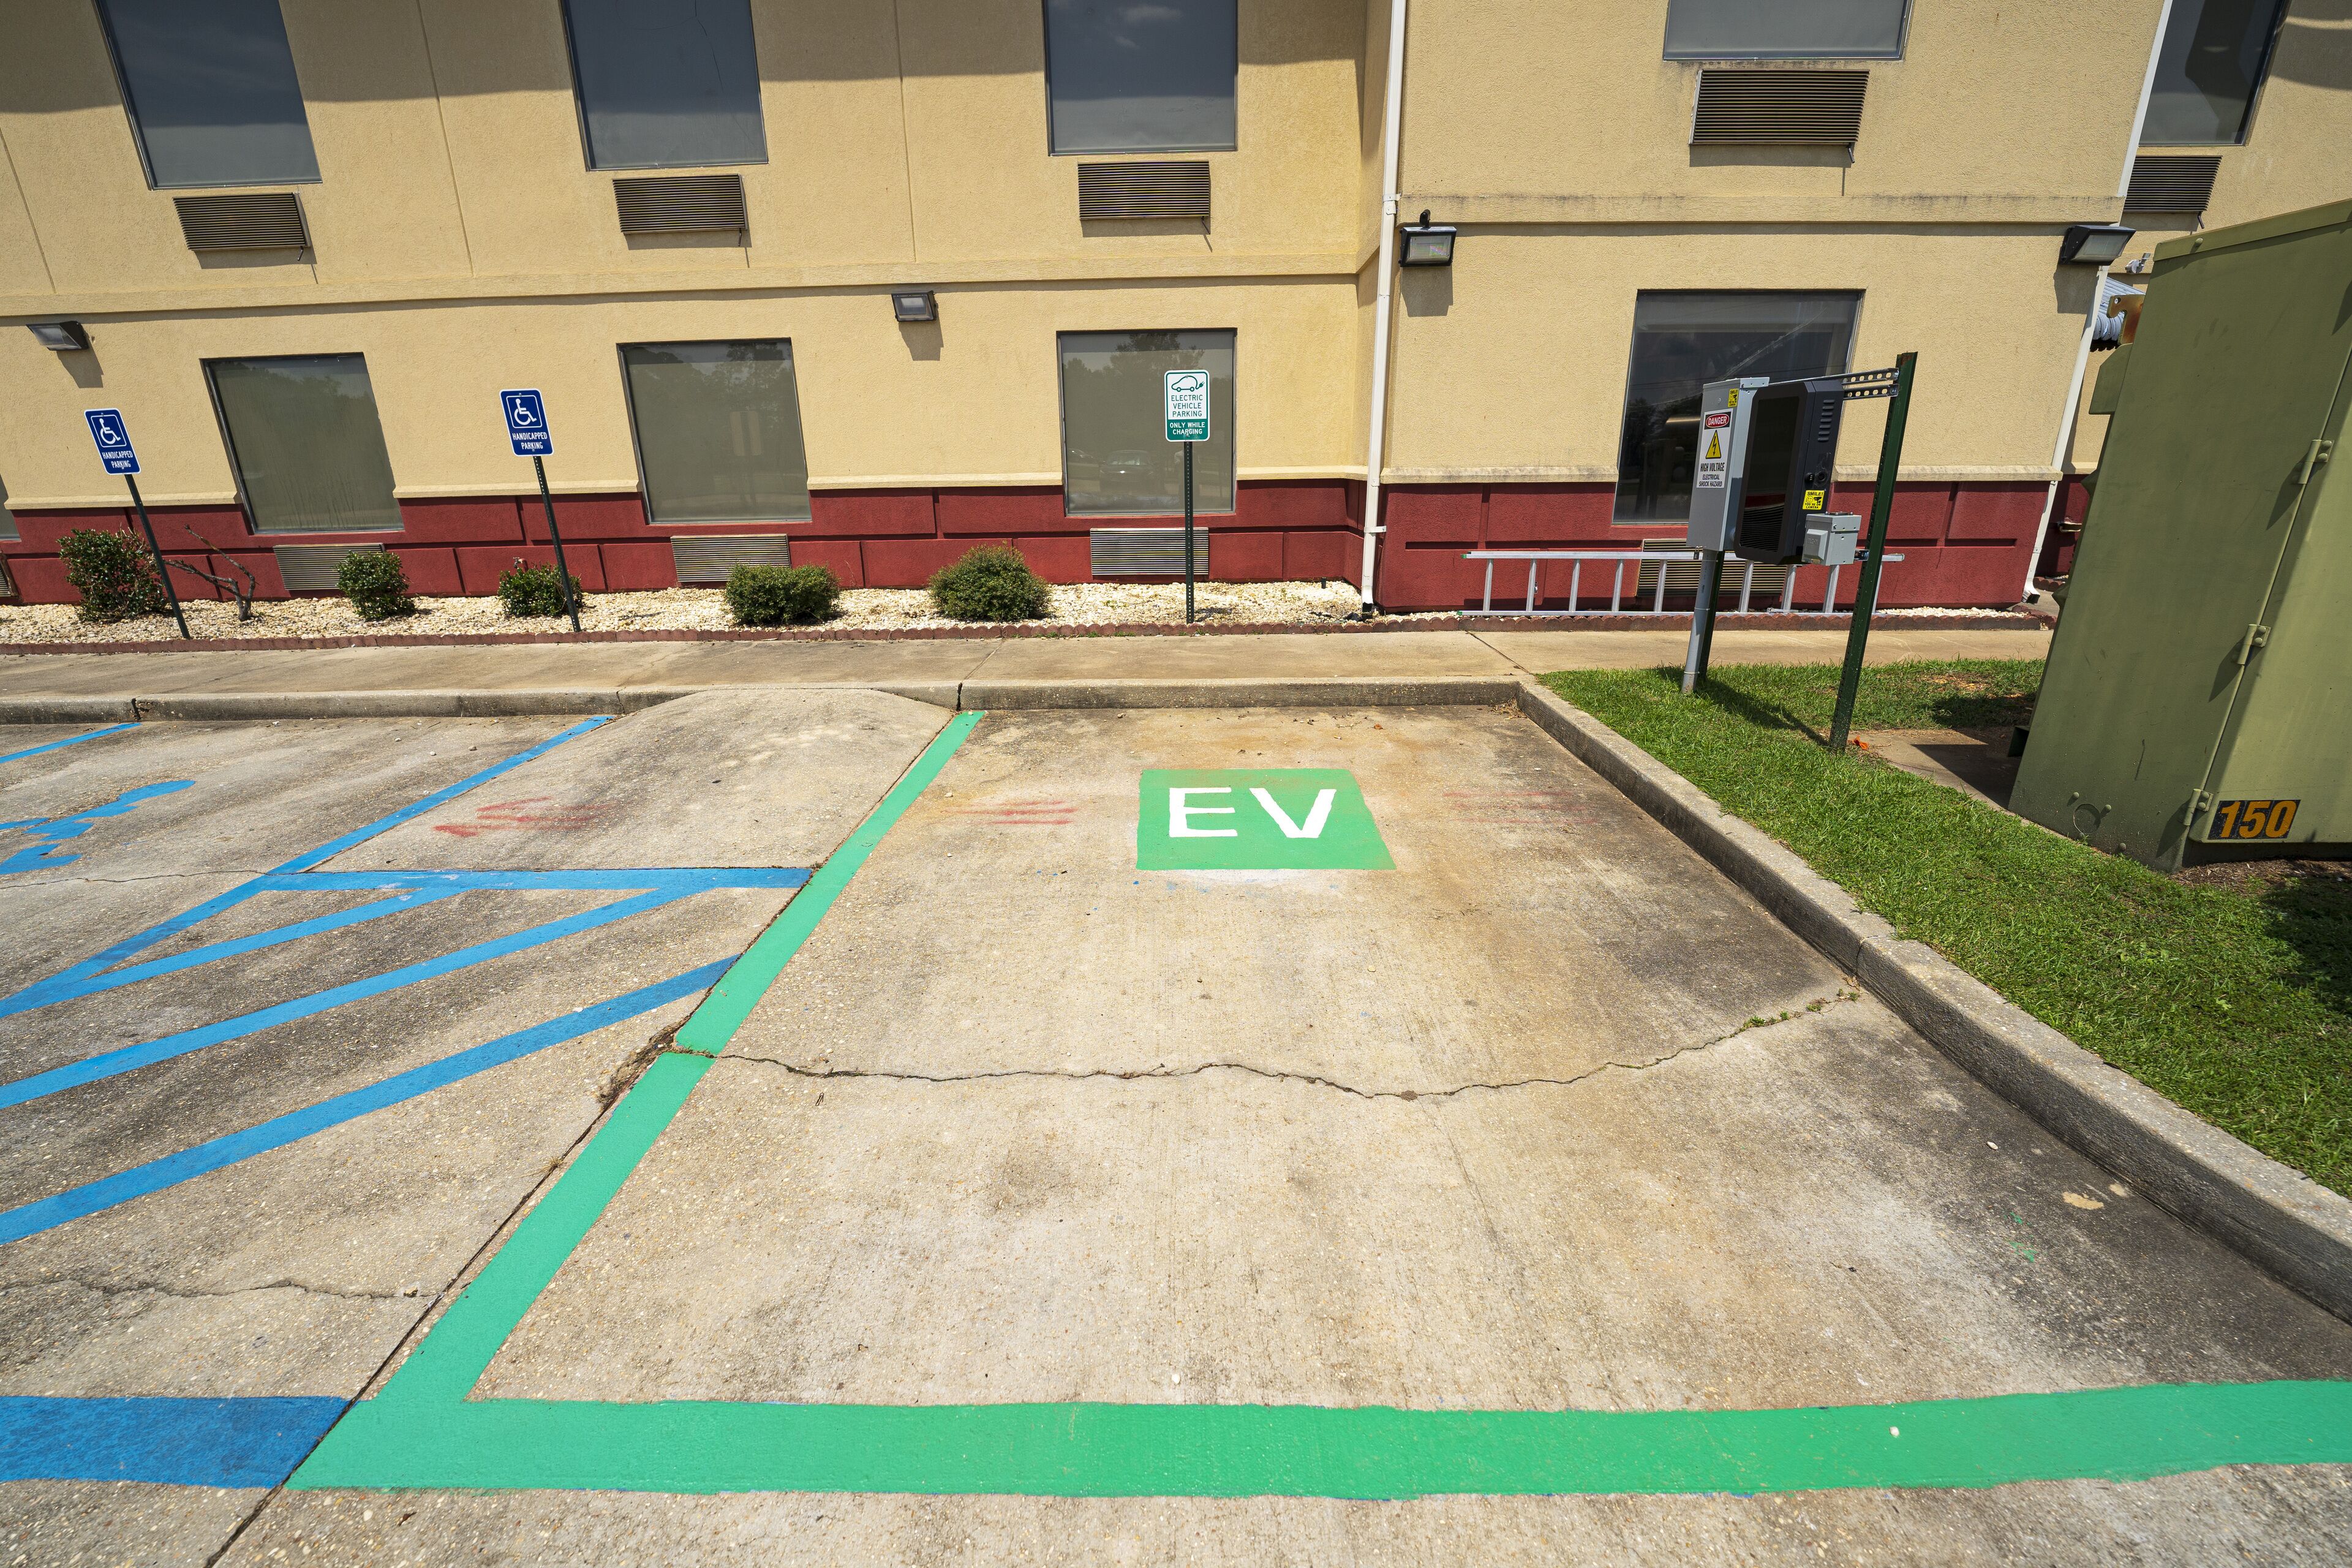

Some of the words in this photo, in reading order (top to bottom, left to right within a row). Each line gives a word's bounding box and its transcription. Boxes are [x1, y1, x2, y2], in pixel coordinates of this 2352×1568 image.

[1708, 416, 1727, 426] DANGER
[102, 450, 133, 459] HANDICAPPED
[111, 460, 131, 469] PARKING
[1700, 462, 1709, 472] HIGH
[1709, 462, 1725, 472] VOLTAGE
[1169, 787, 1336, 838] EV
[2220, 801, 2297, 838] 150
